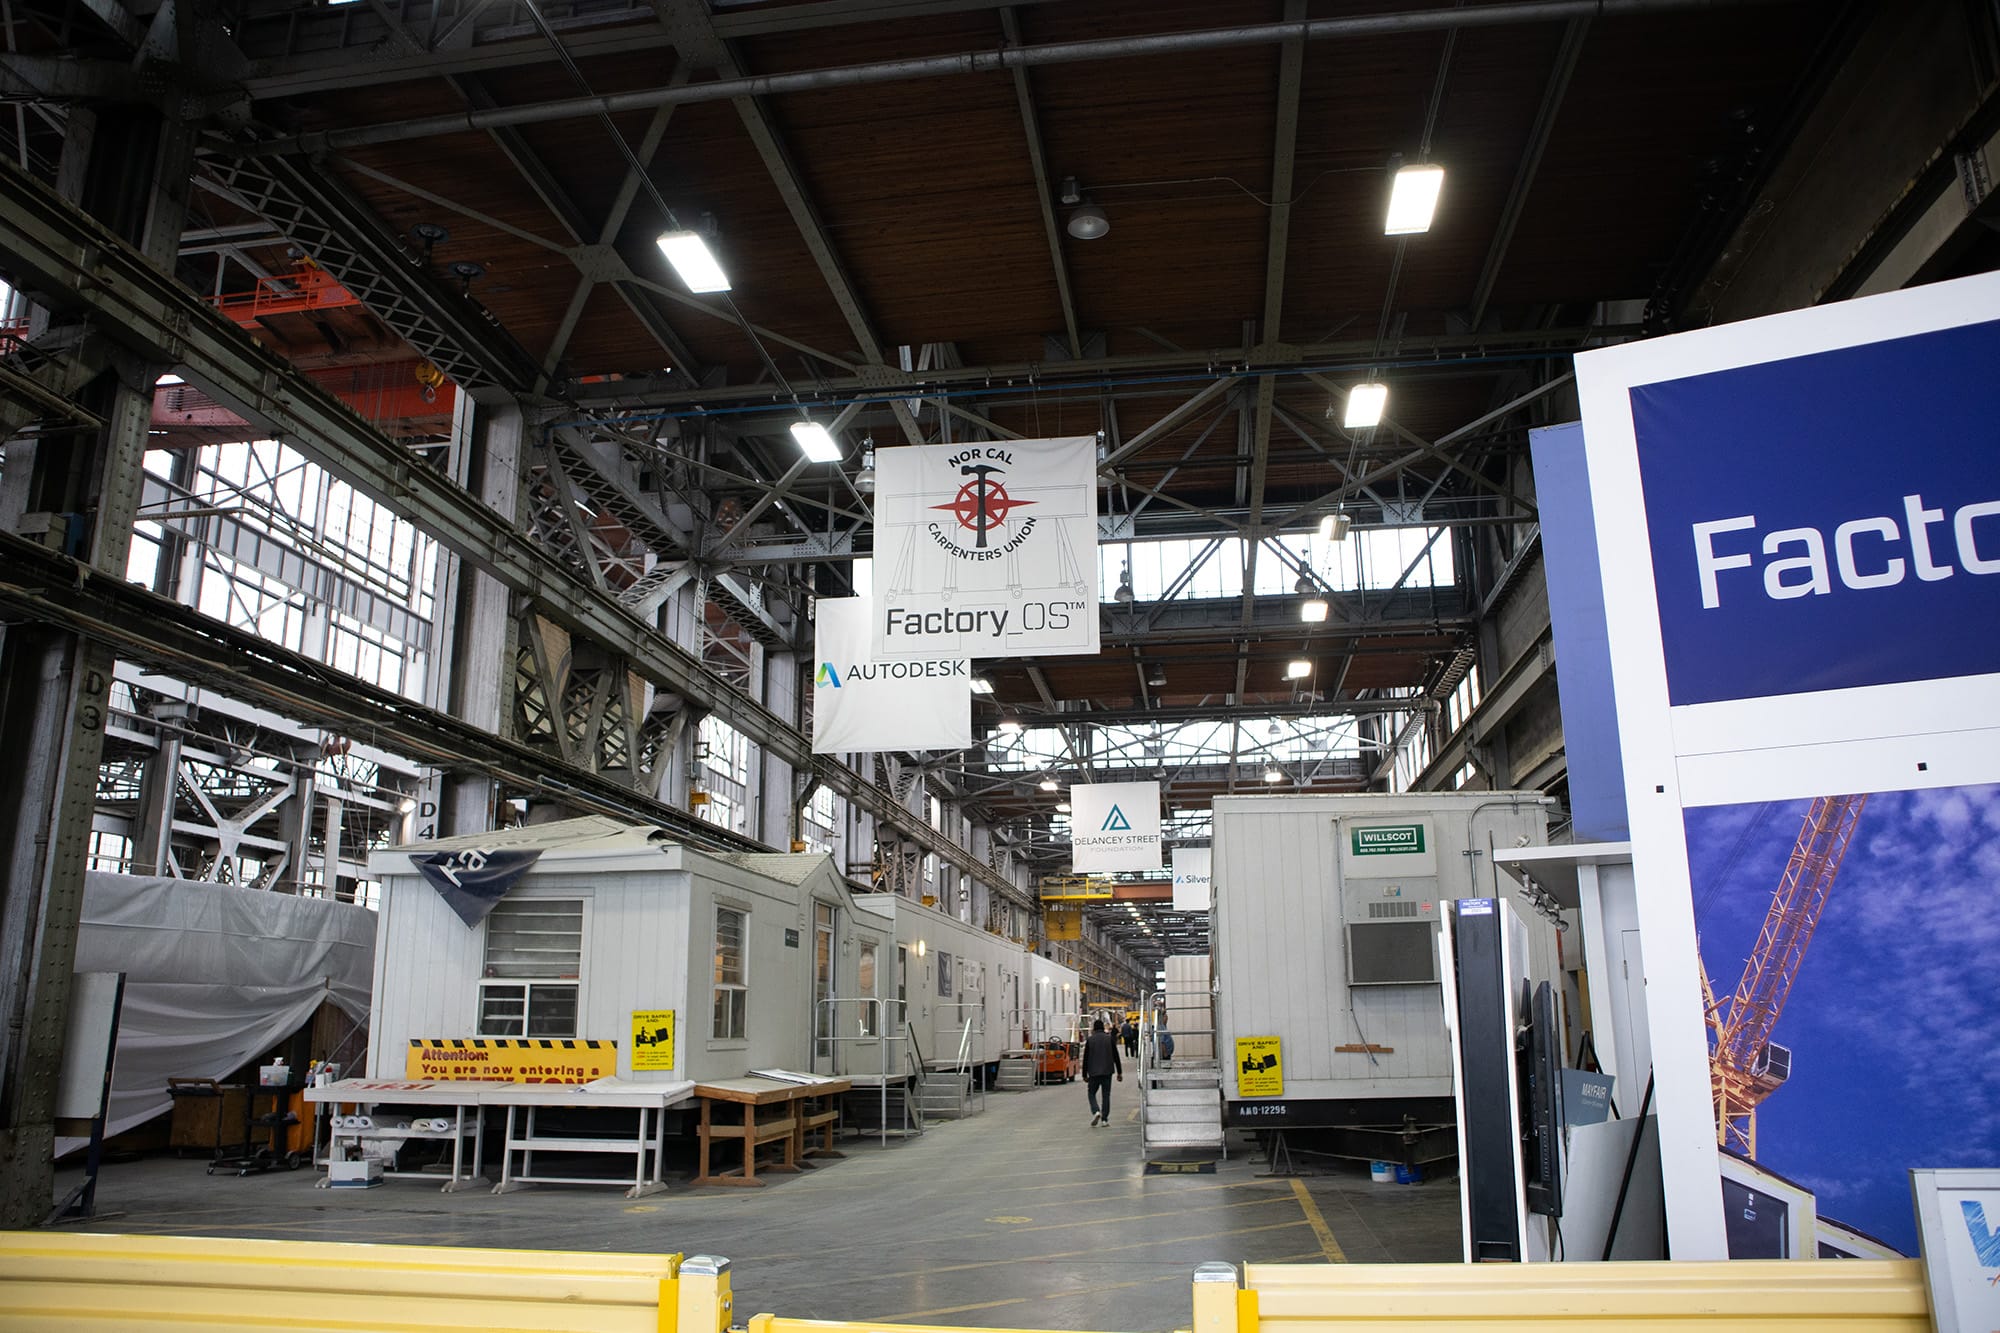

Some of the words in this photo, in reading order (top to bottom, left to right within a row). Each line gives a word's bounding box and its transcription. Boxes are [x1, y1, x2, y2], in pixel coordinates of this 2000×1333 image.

[948, 448, 982, 468] NOR
[986, 448, 1013, 465] CAL
[928, 522, 1002, 561] CARPENTERS
[1003, 516, 1037, 543] UNION
[1692, 494, 2000, 609] Facto
[846, 659, 967, 681] AUTODESK
[1074, 835, 1123, 846] DELANCEY
[1126, 834, 1160, 844] STREET
[1363, 832, 1412, 842] WILLSCOT
[421, 1049, 489, 1061] Attention:
[422, 1064, 448, 1074] You
[453, 1065, 477, 1074] are
[483, 1065, 513, 1075] now
[519, 1065, 585, 1076] entering
[591, 1066, 600, 1075] a
[1581, 1083, 1607, 1100] MAYFAIR
